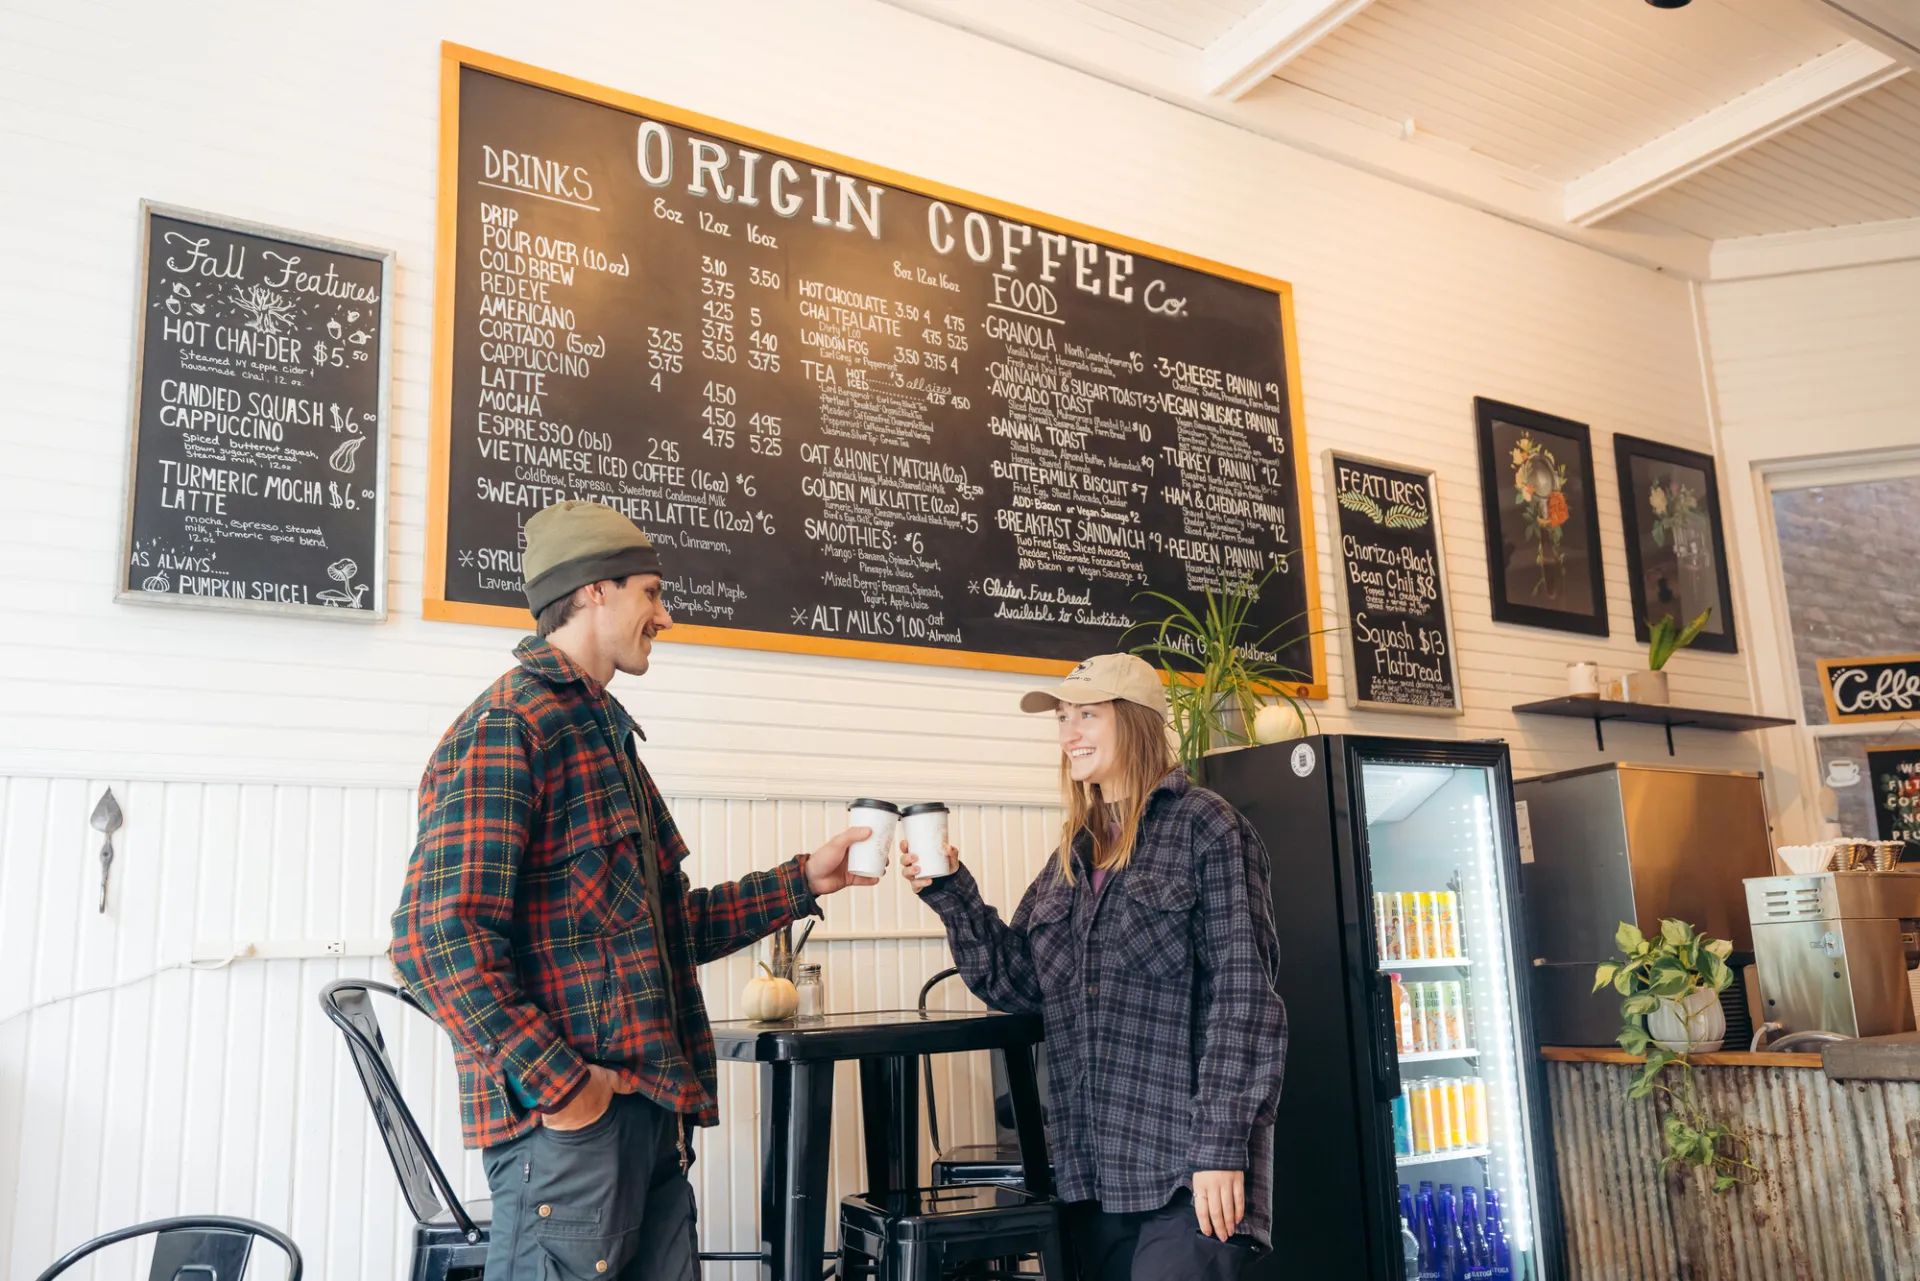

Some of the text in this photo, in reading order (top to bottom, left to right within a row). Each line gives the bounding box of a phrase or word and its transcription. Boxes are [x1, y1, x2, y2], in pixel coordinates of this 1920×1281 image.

[482, 145, 594, 201] DRINKS
[480, 202, 519, 229] DRIP
[637, 120, 1188, 317] ORIGIN COFFEE Co.
[653, 197, 779, 249] 8oz 12oz 16oz
[483, 223, 579, 266] POUR OVER
[164, 231, 380, 304] Fall Features
[479, 248, 575, 286] COLD BREW
[701, 255, 780, 290] 3.10 3.50
[480, 272, 551, 304] RED EYE
[701, 277, 735, 299] 3.75
[799, 279, 824, 299] HOT
[825, 285, 889, 315] CHOCOLATE
[992, 272, 1058, 316] FOOD
[479, 294, 576, 331] AMERICANO
[799, 300, 902, 337] CHAI TEA LATTE
[163, 316, 301, 364] HOT CHAI-DER
[479, 318, 555, 349] CORTADO
[648, 327, 737, 364] 3.25 3.50
[800, 329, 869, 356] LONDON FOG
[986, 315, 1057, 352] GRANOLA
[180, 349, 230, 366] Steamed
[181, 361, 236, 376] housemade
[480, 341, 590, 379] CAPPUCCINO
[800, 359, 836, 385] TEA
[481, 366, 548, 396] LATTE
[703, 380, 736, 405] 4.50
[990, 361, 1144, 408] CINNAMON & SUGAR TOAST
[991, 380, 1094, 415] AVOCADO TOAST
[1226, 373, 1263, 399] PANINI
[160, 379, 324, 426] CANDIED SQUASH
[478, 388, 543, 417] MOCHA
[1158, 392, 1279, 436] VEGAN SAUSAGE PANINI
[159, 405, 284, 442] CAPPUCCINO
[478, 412, 680, 463] ESPRESSO 2.95
[702, 426, 782, 456] 4.75 5.25
[749, 412, 782, 436] 4.95
[991, 416, 1088, 450] BANANA TOAST
[229, 438, 280, 453] butternut
[800, 443, 943, 483] OAT & HONEY MATCHA
[477, 437, 593, 474] VIETNAMESE
[599, 454, 628, 478] ICED
[632, 460, 685, 487] COFFEE
[735, 473, 757, 497] $6
[993, 460, 1078, 489] BUTTERMILK
[1083, 474, 1129, 497] BISCUIT
[1162, 446, 1211, 473] TURKEY
[1218, 457, 1257, 482] PANINI
[158, 460, 323, 505] TURMERIC MOCHA
[802, 476, 932, 513] GOLDEN MILK LATTE
[1339, 467, 1426, 510] FEATURES
[161, 487, 227, 516] LATTE
[656, 501, 710, 528] LATTE
[1164, 486, 1285, 524] HAM & CHEDDAR PANINI
[998, 509, 1072, 540] BREAKFAST
[1076, 520, 1146, 550] SANDWICH
[131, 552, 150, 568] AS
[477, 548, 524, 572] SYRU
[1169, 537, 1264, 571] REUBEN PANINI
[179, 574, 309, 606] PUMPKIN SPICE!
[689, 577, 715, 596] Local
[983, 577, 1092, 606] Gluten Free Bread
[1349, 562, 1383, 586] Bean
[1386, 569, 1414, 595] Chili
[811, 605, 843, 632] ALT
[847, 610, 894, 636] MILKS
[994, 602, 1137, 629] Available to Substitute
[1357, 612, 1415, 651] Squash
[1374, 648, 1443, 682] Flatbread
[1832, 668, 1920, 713] Coffe
[1888, 779, 1920, 791] FILT
